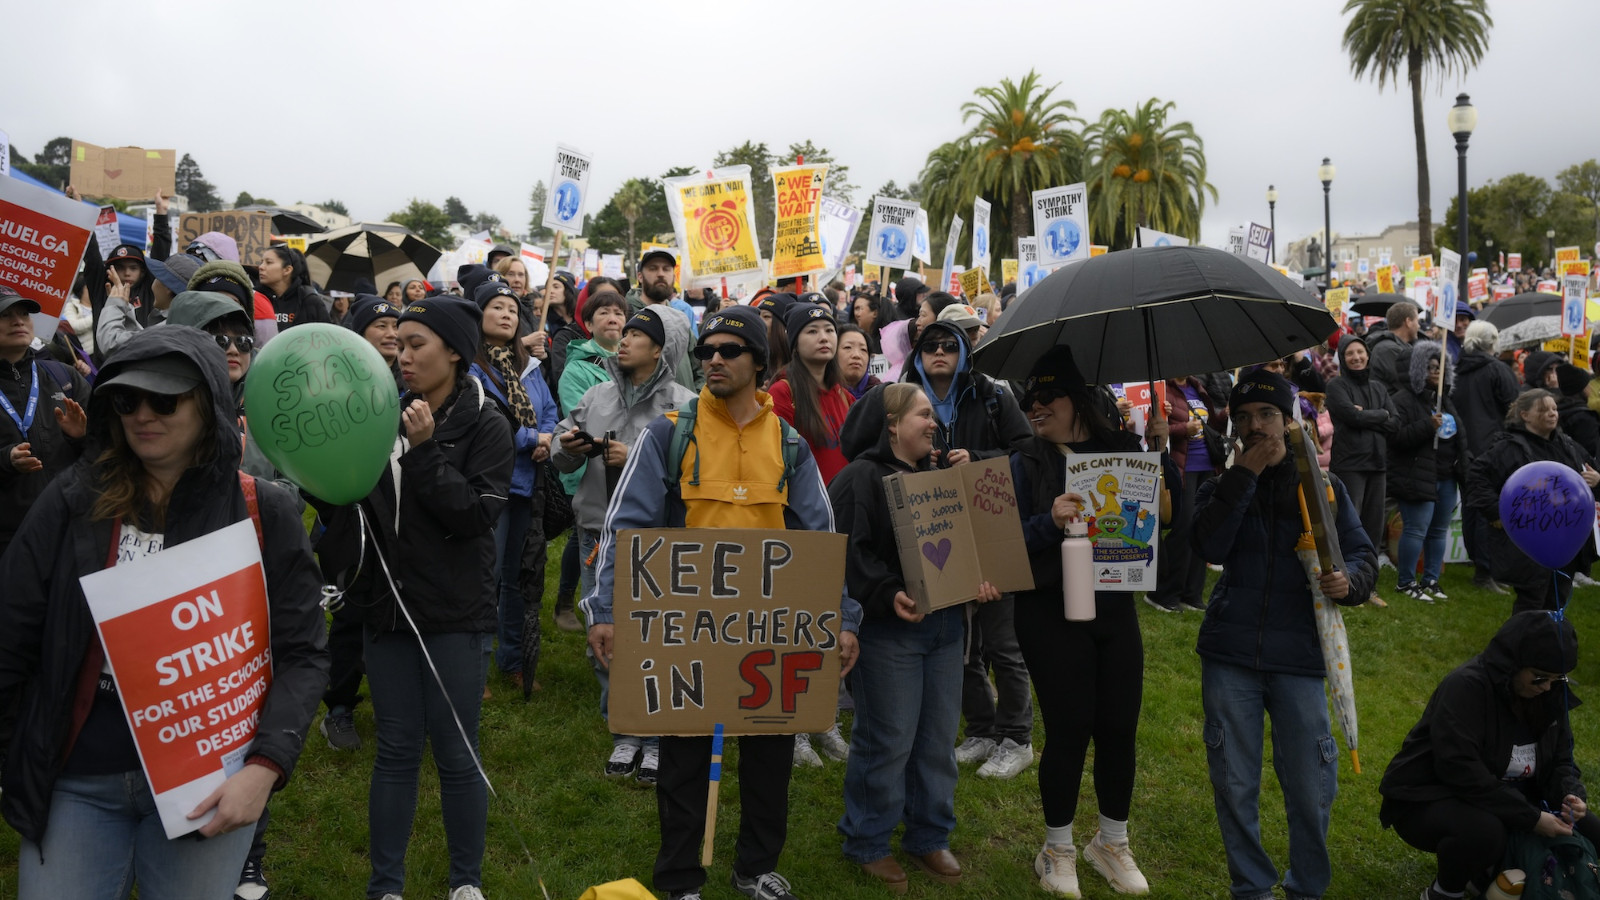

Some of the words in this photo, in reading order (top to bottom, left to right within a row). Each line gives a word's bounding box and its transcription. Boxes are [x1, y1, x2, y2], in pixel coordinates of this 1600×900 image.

[557, 152, 590, 172] SYMPATHY
[560, 165, 581, 181] STRIKE
[700, 183, 722, 197] CAN'T
[724, 181, 744, 192] WAIT
[787, 176, 812, 190] WE
[778, 201, 816, 218] WAIT
[877, 204, 916, 218] SYMPATHY
[1037, 193, 1082, 210] SYMPATHY
[881, 214, 906, 226] STRIKE
[1045, 204, 1073, 219] STRIKE
[0, 219, 69, 257] HUELGA
[182, 213, 271, 246] SUPPORT
[708, 225, 733, 244] UP
[1249, 225, 1271, 247] SEIU
[1, 242, 57, 269] ESCUELAS
[0, 256, 43, 278] EGURAS
[43, 271, 53, 281] Y
[0, 270, 20, 284] LES
[20, 277, 66, 300] AHORA!
[725, 318, 745, 328] UESF
[1257, 383, 1276, 391] UESF
[1067, 461, 1089, 475] WE
[1090, 457, 1124, 469] CAN'T
[1125, 457, 1159, 475] WAIT!
[984, 466, 1011, 487] Fair
[1134, 476, 1146, 484] SAN
[1122, 489, 1153, 499] EDUCATORS
[1124, 482, 1153, 492] FRANCISCO
[1109, 547, 1139, 555] SCHOOLS
[1121, 552, 1149, 560] DESERVE
[630, 534, 793, 602] KEEP
[170, 590, 225, 631] ON
[630, 607, 837, 651] TEACHERS
[155, 620, 256, 687] STRIKE
[132, 699, 178, 729] FOR
[181, 682, 217, 712] THE
[219, 646, 271, 695] SCHOOLS
[738, 648, 825, 714] SF
[158, 716, 205, 745] OUR
[207, 675, 268, 726] STUDENTS
[195, 711, 261, 757] DESERVE
